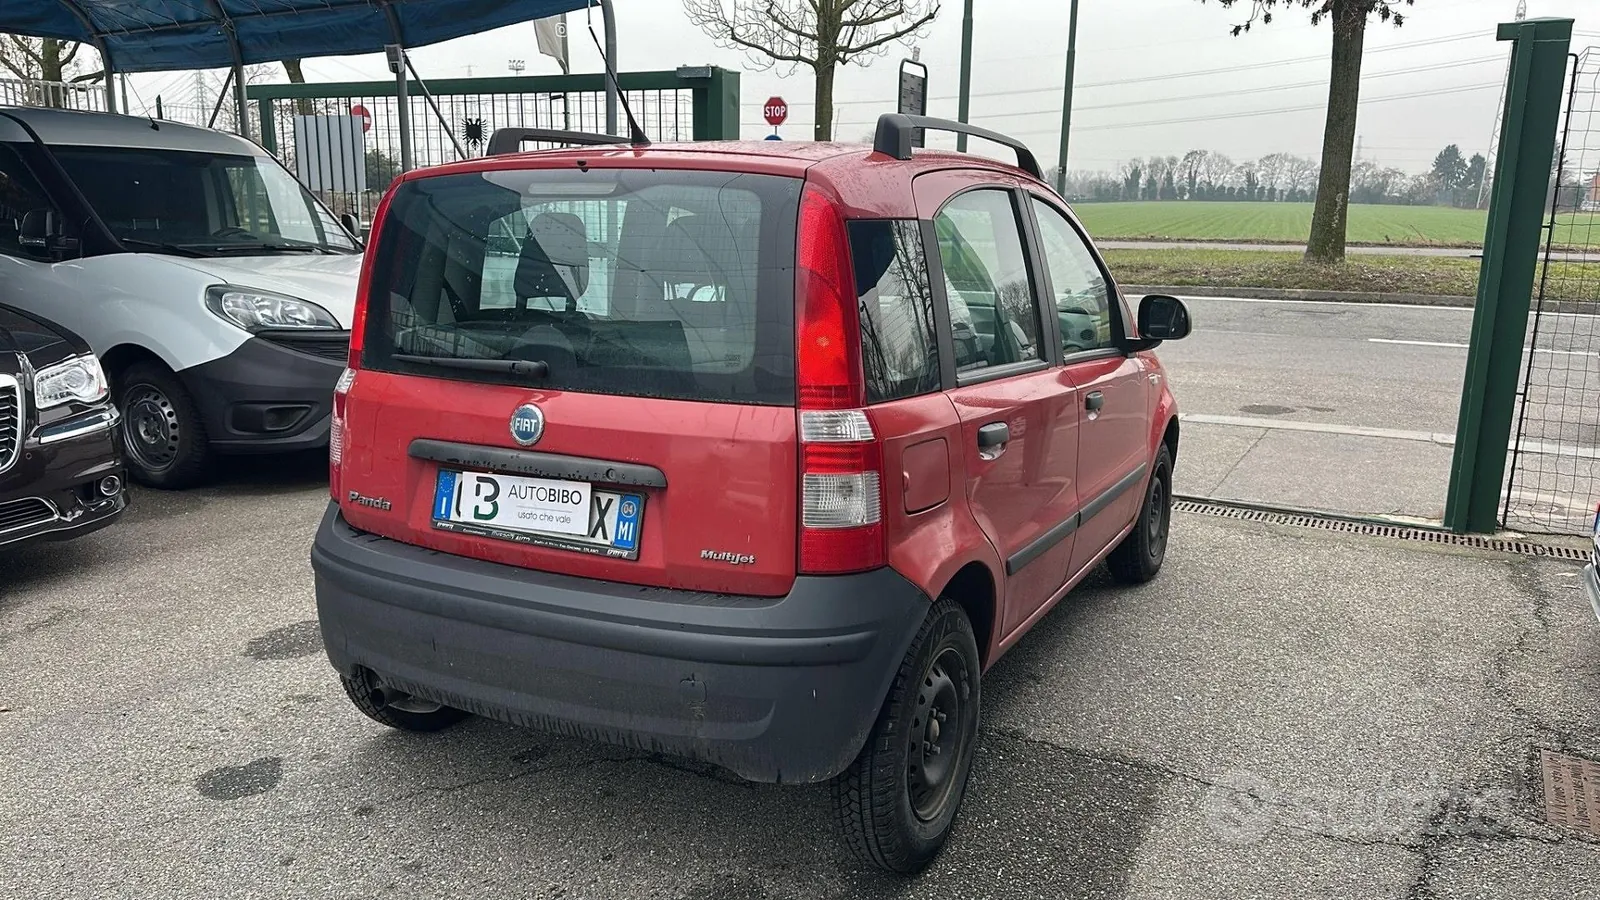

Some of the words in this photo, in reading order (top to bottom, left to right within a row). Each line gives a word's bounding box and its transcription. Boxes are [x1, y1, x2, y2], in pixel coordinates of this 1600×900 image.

[765, 105, 786, 117] STOP
[515, 417, 537, 432] FIAT
[349, 490, 391, 510] Panda
[508, 484, 582, 505] AUTOBIBO
[517, 511, 537, 520] usato
[539, 514, 554, 522] che
[556, 515, 571, 524] vale
[617, 520, 634, 541] MI
